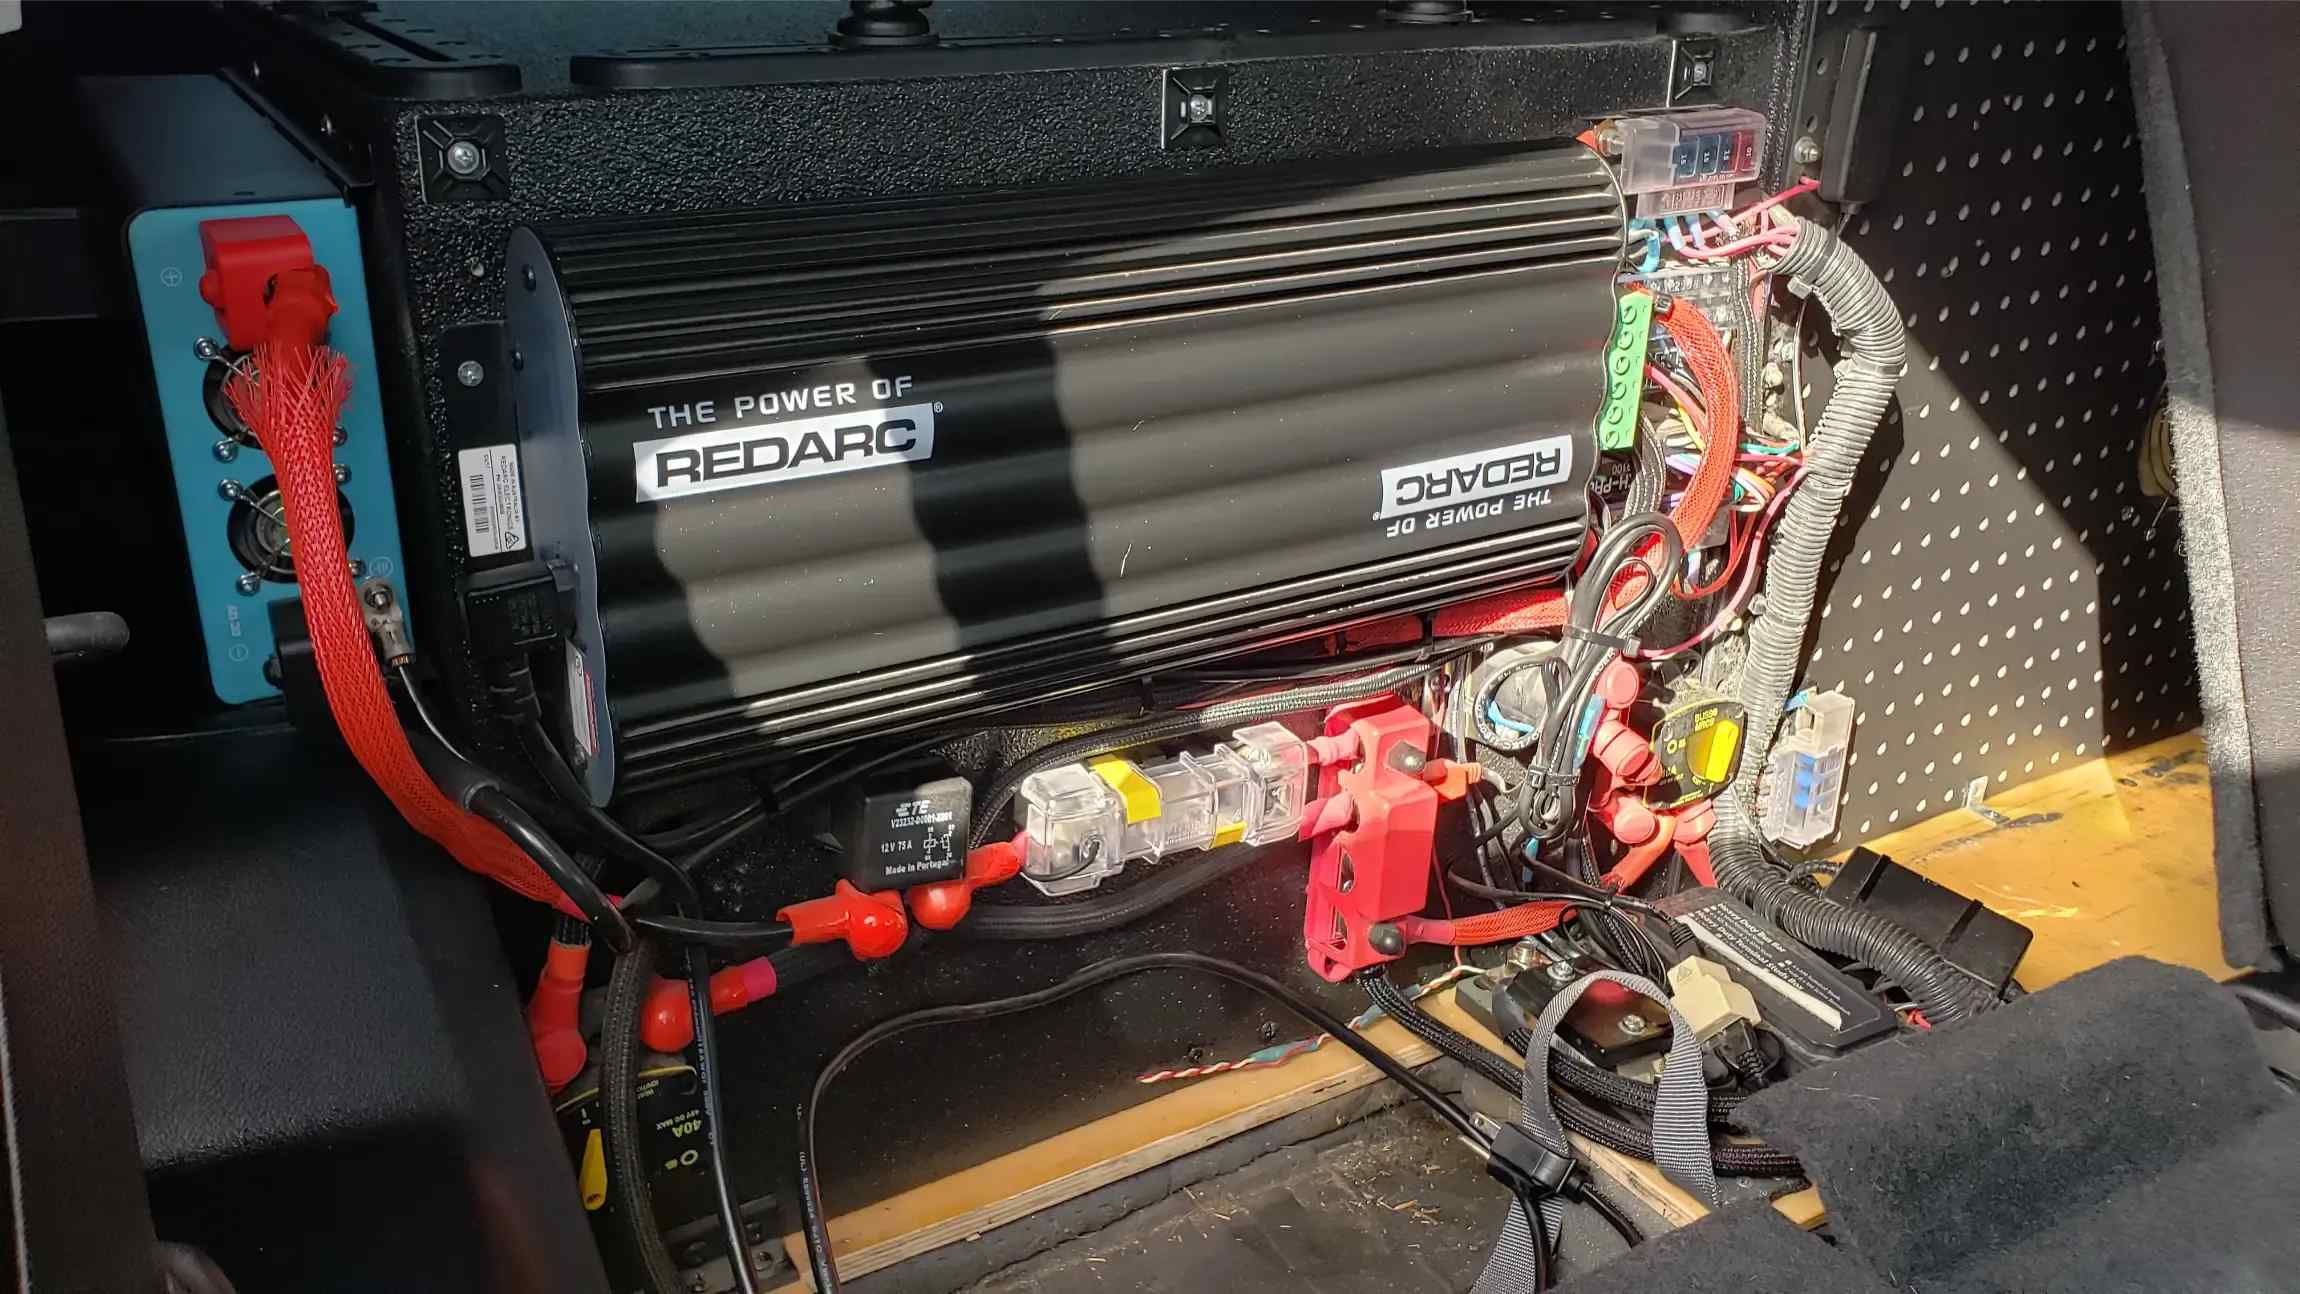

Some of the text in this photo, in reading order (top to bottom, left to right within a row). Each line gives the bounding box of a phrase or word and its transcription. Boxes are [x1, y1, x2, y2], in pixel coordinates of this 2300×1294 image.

[648, 376, 913, 429] THE POWER OF
[656, 419, 917, 488] REDARC
[1396, 448, 1561, 507] REDARC
[1386, 488, 1552, 538] THE POWER OF
[886, 864, 906, 875] Made
[917, 859, 949, 871] Portugal
[671, 1119, 702, 1137] 40A
